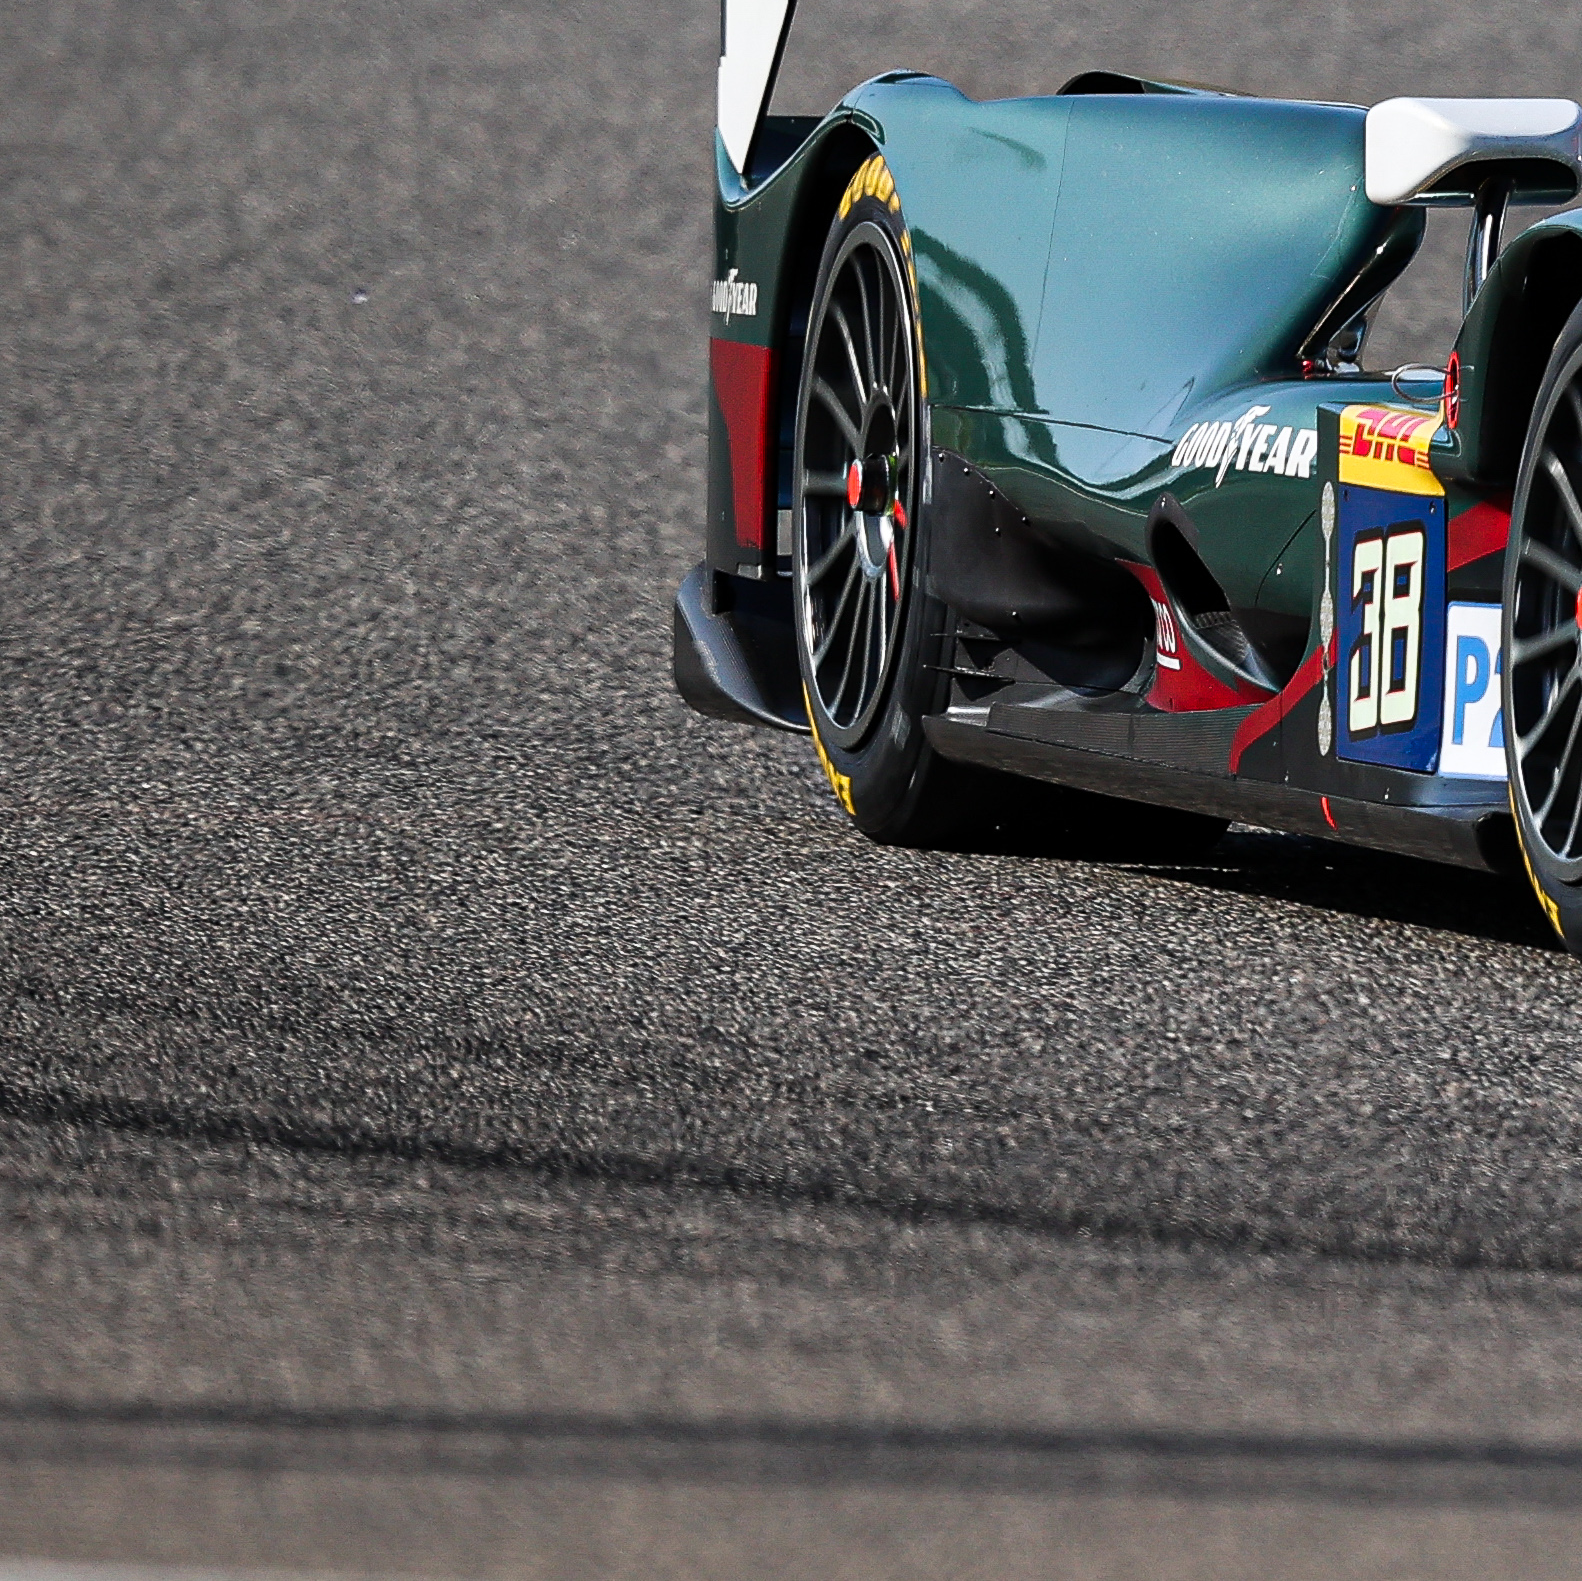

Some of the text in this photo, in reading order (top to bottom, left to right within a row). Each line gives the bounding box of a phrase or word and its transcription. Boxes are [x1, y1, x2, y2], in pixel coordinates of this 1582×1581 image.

[1171, 418, 1317, 479] GOODYEAR
[1353, 408, 1429, 465] DHL
[1348, 530, 1425, 734] 38
